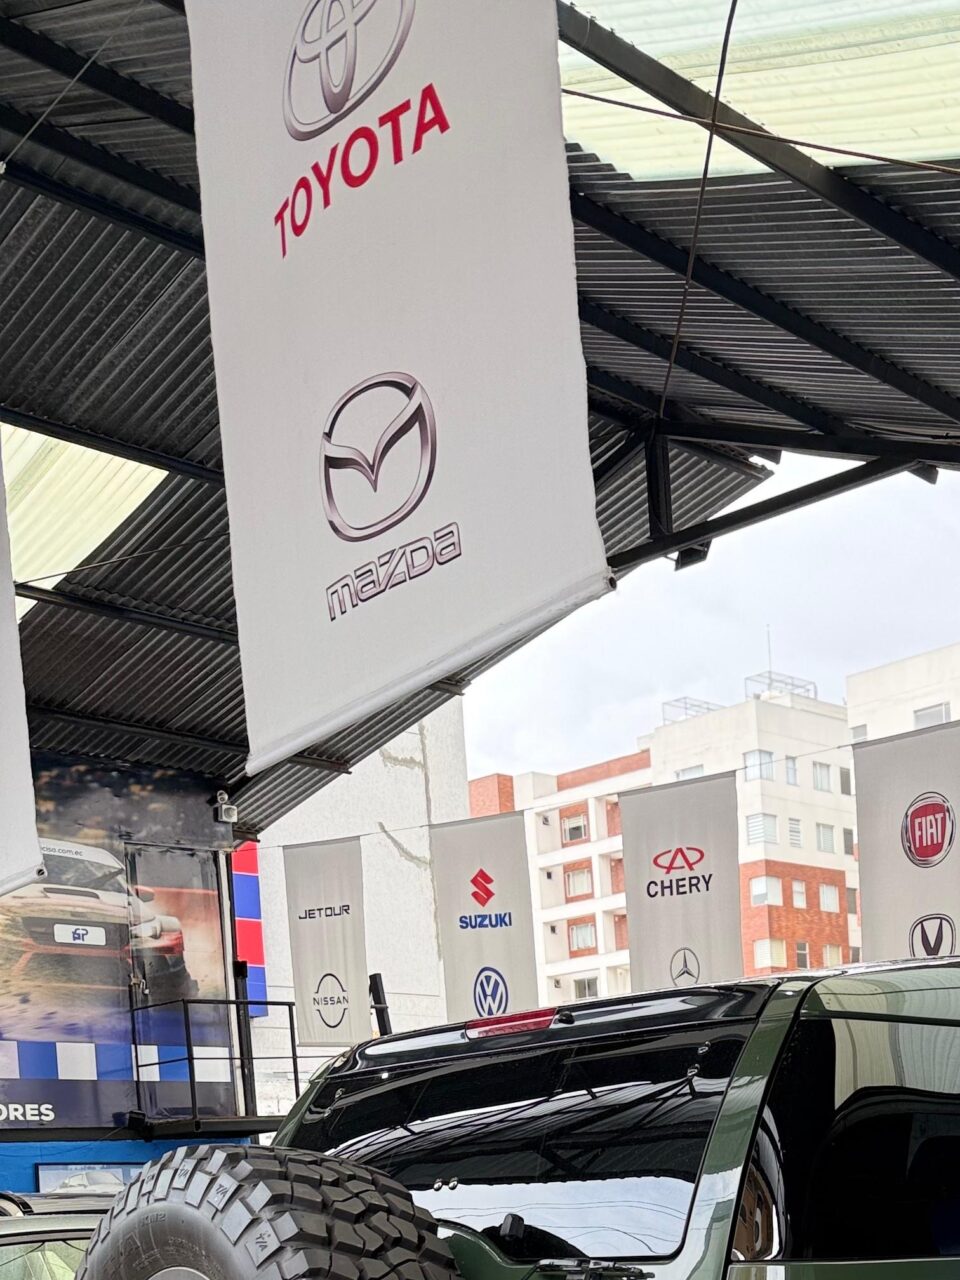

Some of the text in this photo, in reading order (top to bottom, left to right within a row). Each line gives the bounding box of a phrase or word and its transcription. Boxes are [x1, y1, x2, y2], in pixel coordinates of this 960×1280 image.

[273, 82, 452, 259] TOYOTA
[914, 813, 946, 849] FIAT
[41, 846, 83, 857] ciso.com.ec
[646, 873, 713, 899] CHERY
[298, 904, 350, 920] JETOUR
[459, 912, 513, 930] SUZUKI
[313, 995, 349, 1007] NISSAN
